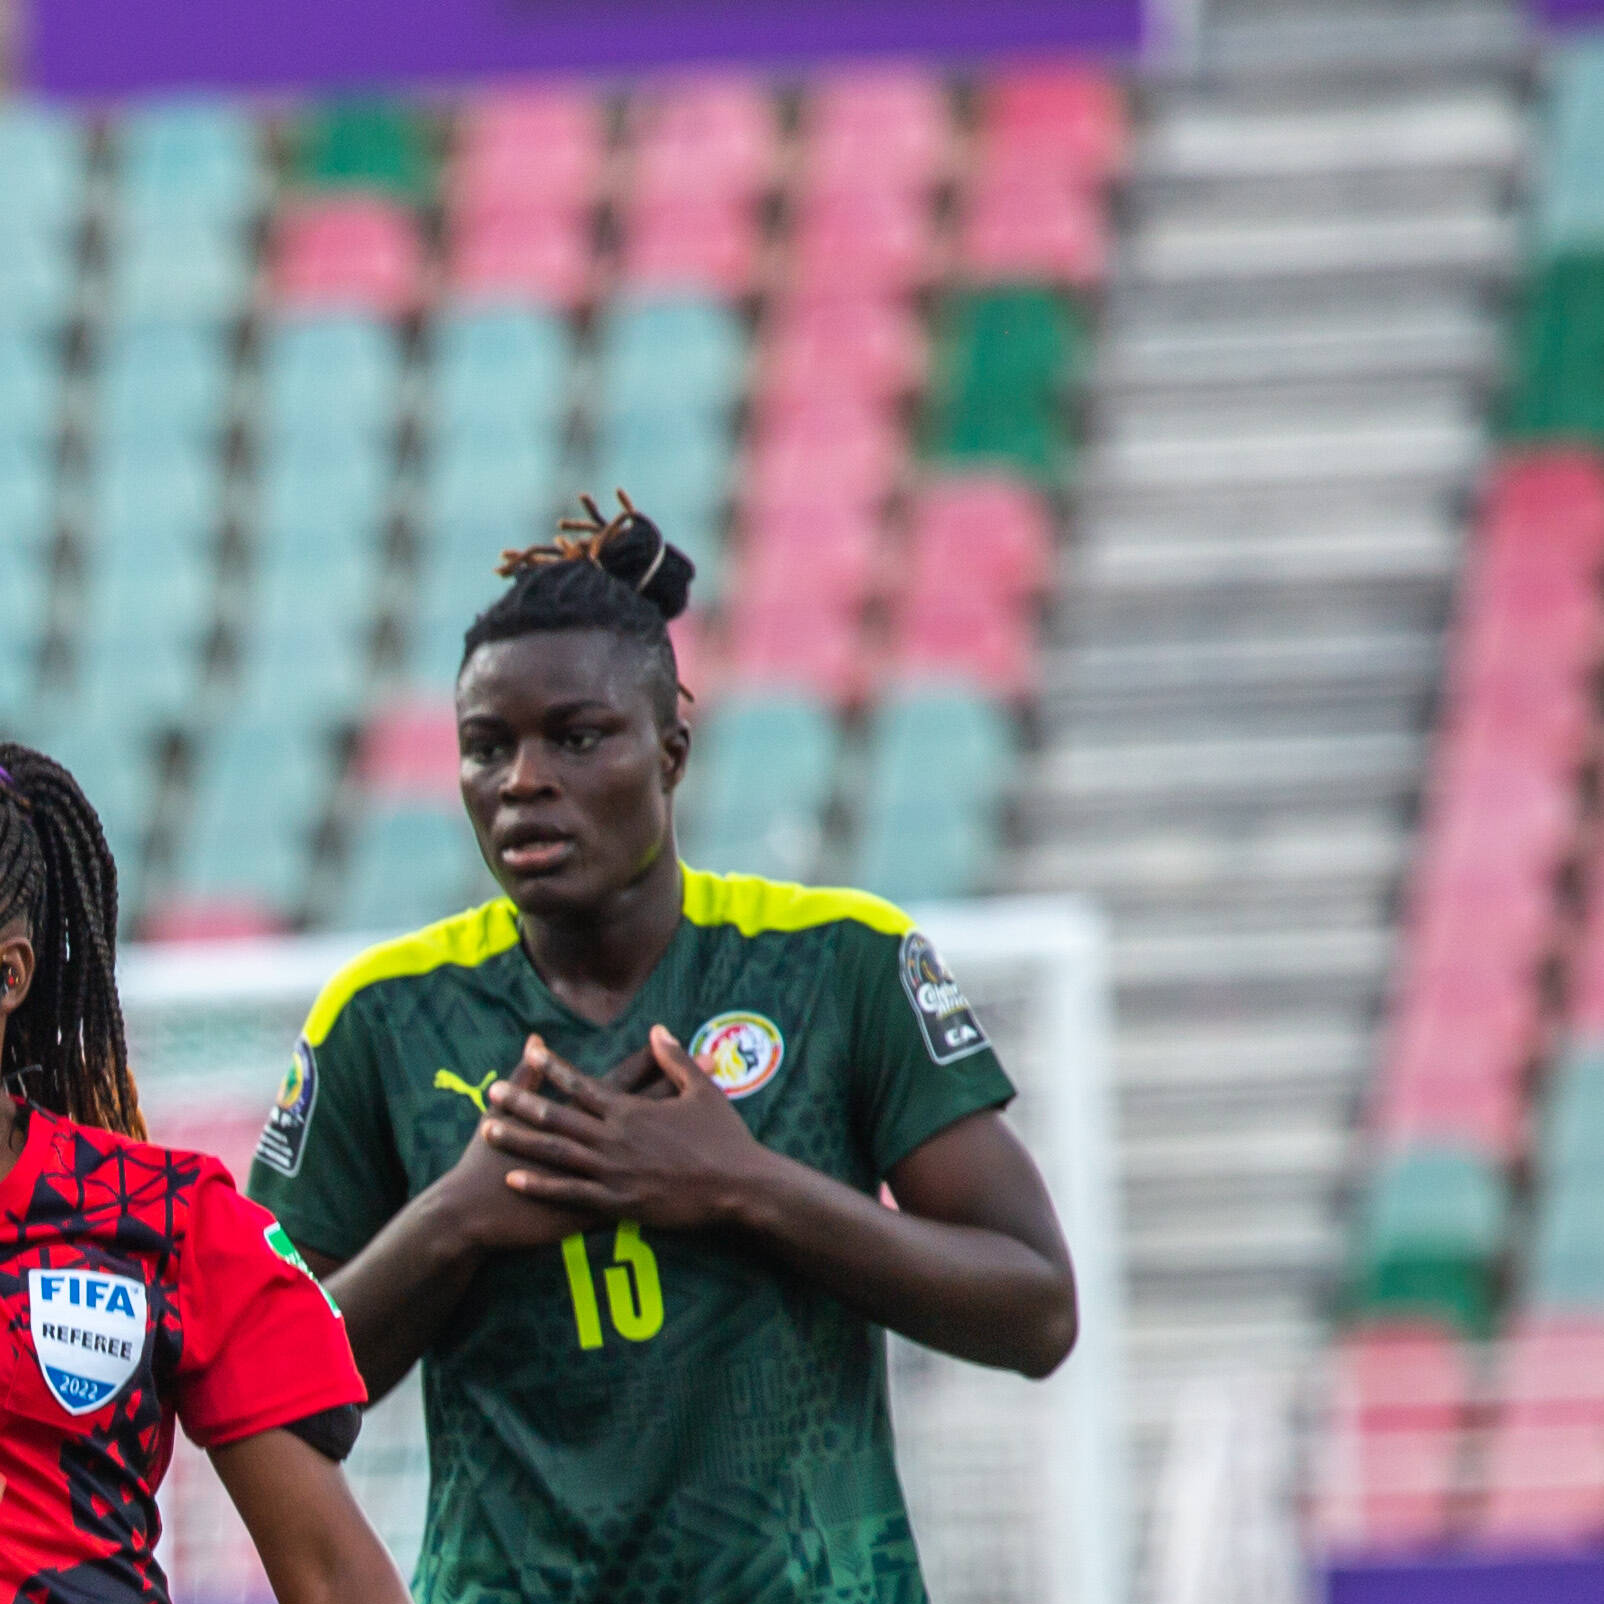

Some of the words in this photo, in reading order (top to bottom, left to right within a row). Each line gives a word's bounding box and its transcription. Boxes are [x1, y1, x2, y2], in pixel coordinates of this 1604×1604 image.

[943, 1024, 978, 1048] CA
[40, 1275, 136, 1319] FIFA
[561, 1219, 664, 1350] 13
[41, 1321, 134, 1361] REFEREE
[59, 1374, 99, 1402] 2022
